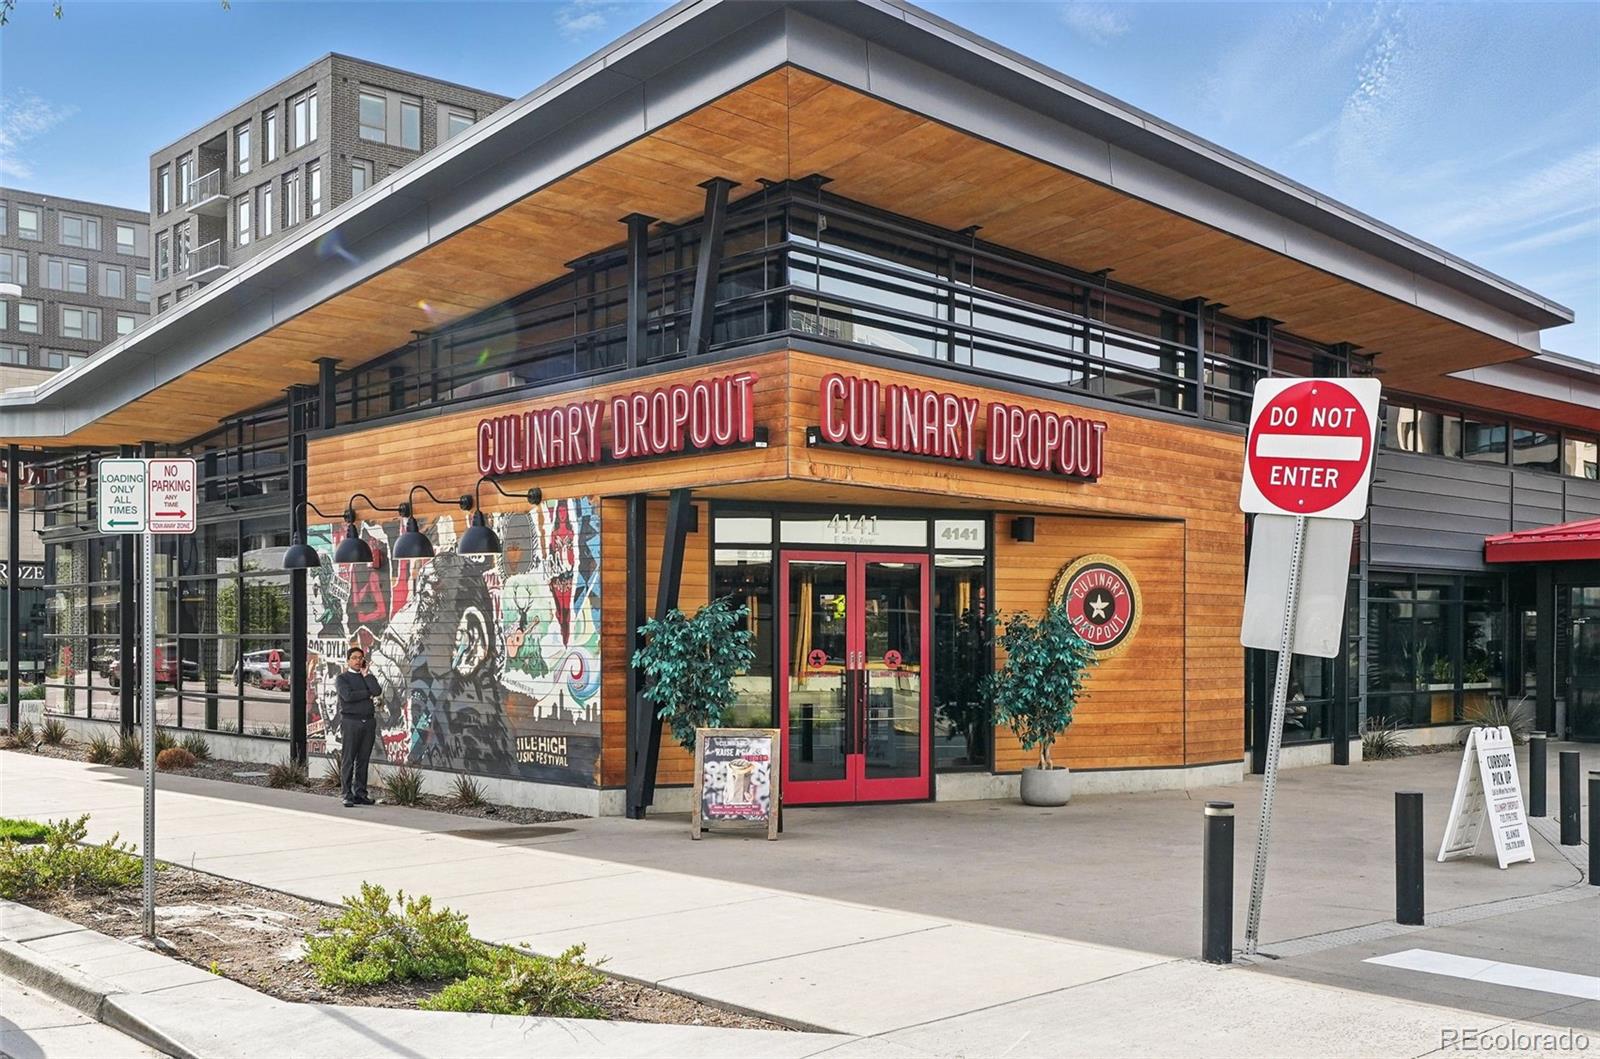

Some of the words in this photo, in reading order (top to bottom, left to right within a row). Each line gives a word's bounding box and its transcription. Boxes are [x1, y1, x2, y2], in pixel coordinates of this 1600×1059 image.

[477, 399, 605, 476] CULINARY
[611, 371, 759, 460] DROPOUT
[1269, 406, 1298, 427] DO
[1311, 407, 1356, 428] NOT
[820, 373, 979, 461] CULINARY
[986, 402, 1107, 478] DROPOUT
[101, 474, 144, 483] LOADING
[164, 465, 178, 477] NO
[1270, 466, 1339, 489] ENTER
[110, 485, 135, 493] ONLY
[151, 480, 191, 492] PARKING
[113, 496, 132, 504] ALL
[108, 506, 138, 514] TIMES
[826, 513, 879, 535] 4141
[941, 527, 978, 540] 4141
[1073, 572, 1126, 599] CULINARY
[326, 640, 347, 658] DYLA
[538, 736, 567, 755] HIGH
[516, 751, 534, 762] USIC
[535, 751, 569, 767] FESTIVAL
[1487, 753, 1512, 769] CURBSIDE
[1492, 771, 1504, 786] PICK
[1504, 770, 1512, 785] UP
